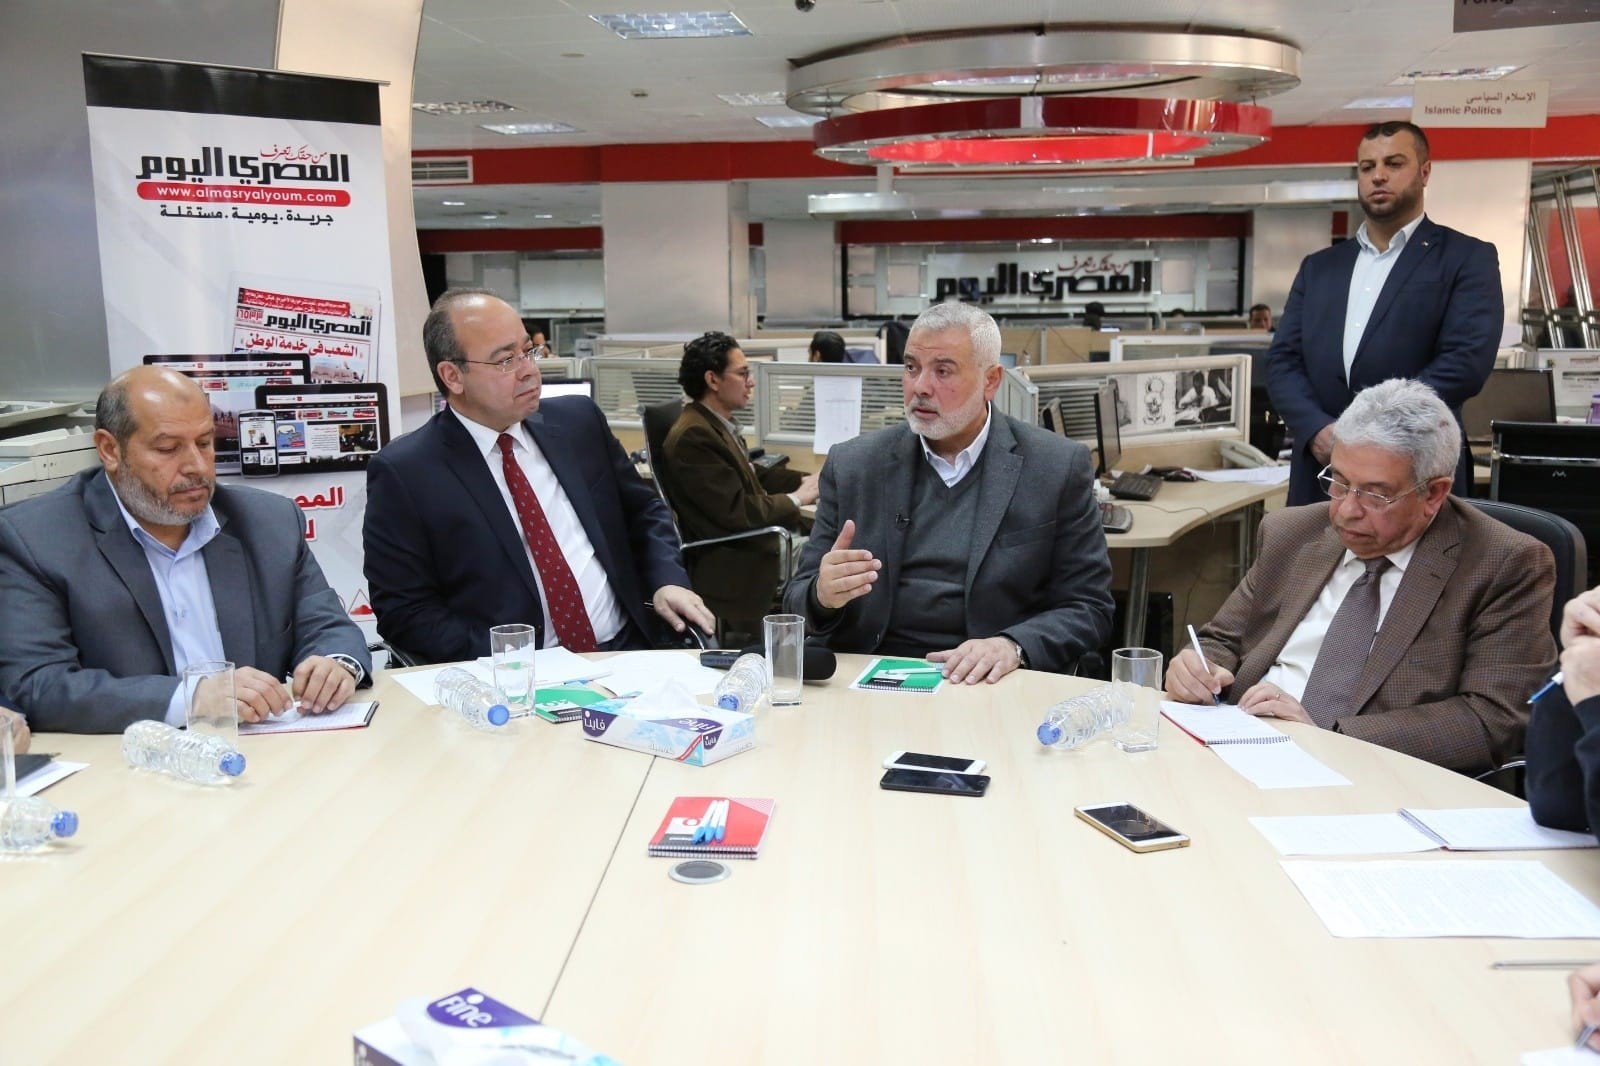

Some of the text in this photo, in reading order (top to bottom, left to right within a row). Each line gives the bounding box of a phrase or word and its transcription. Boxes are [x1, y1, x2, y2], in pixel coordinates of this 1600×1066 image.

[1424, 105, 1502, 115] Islamic Politics
[136, 147, 223, 183] اليوم
[157, 186, 337, 203] www.almasryalyoum.com
[930, 262, 1018, 303] اليوم
[264, 313, 308, 331] اليوم
[245, 332, 278, 350] الوطن
[279, 335, 307, 351] خدمة
[437, 993, 493, 1027] Fine
